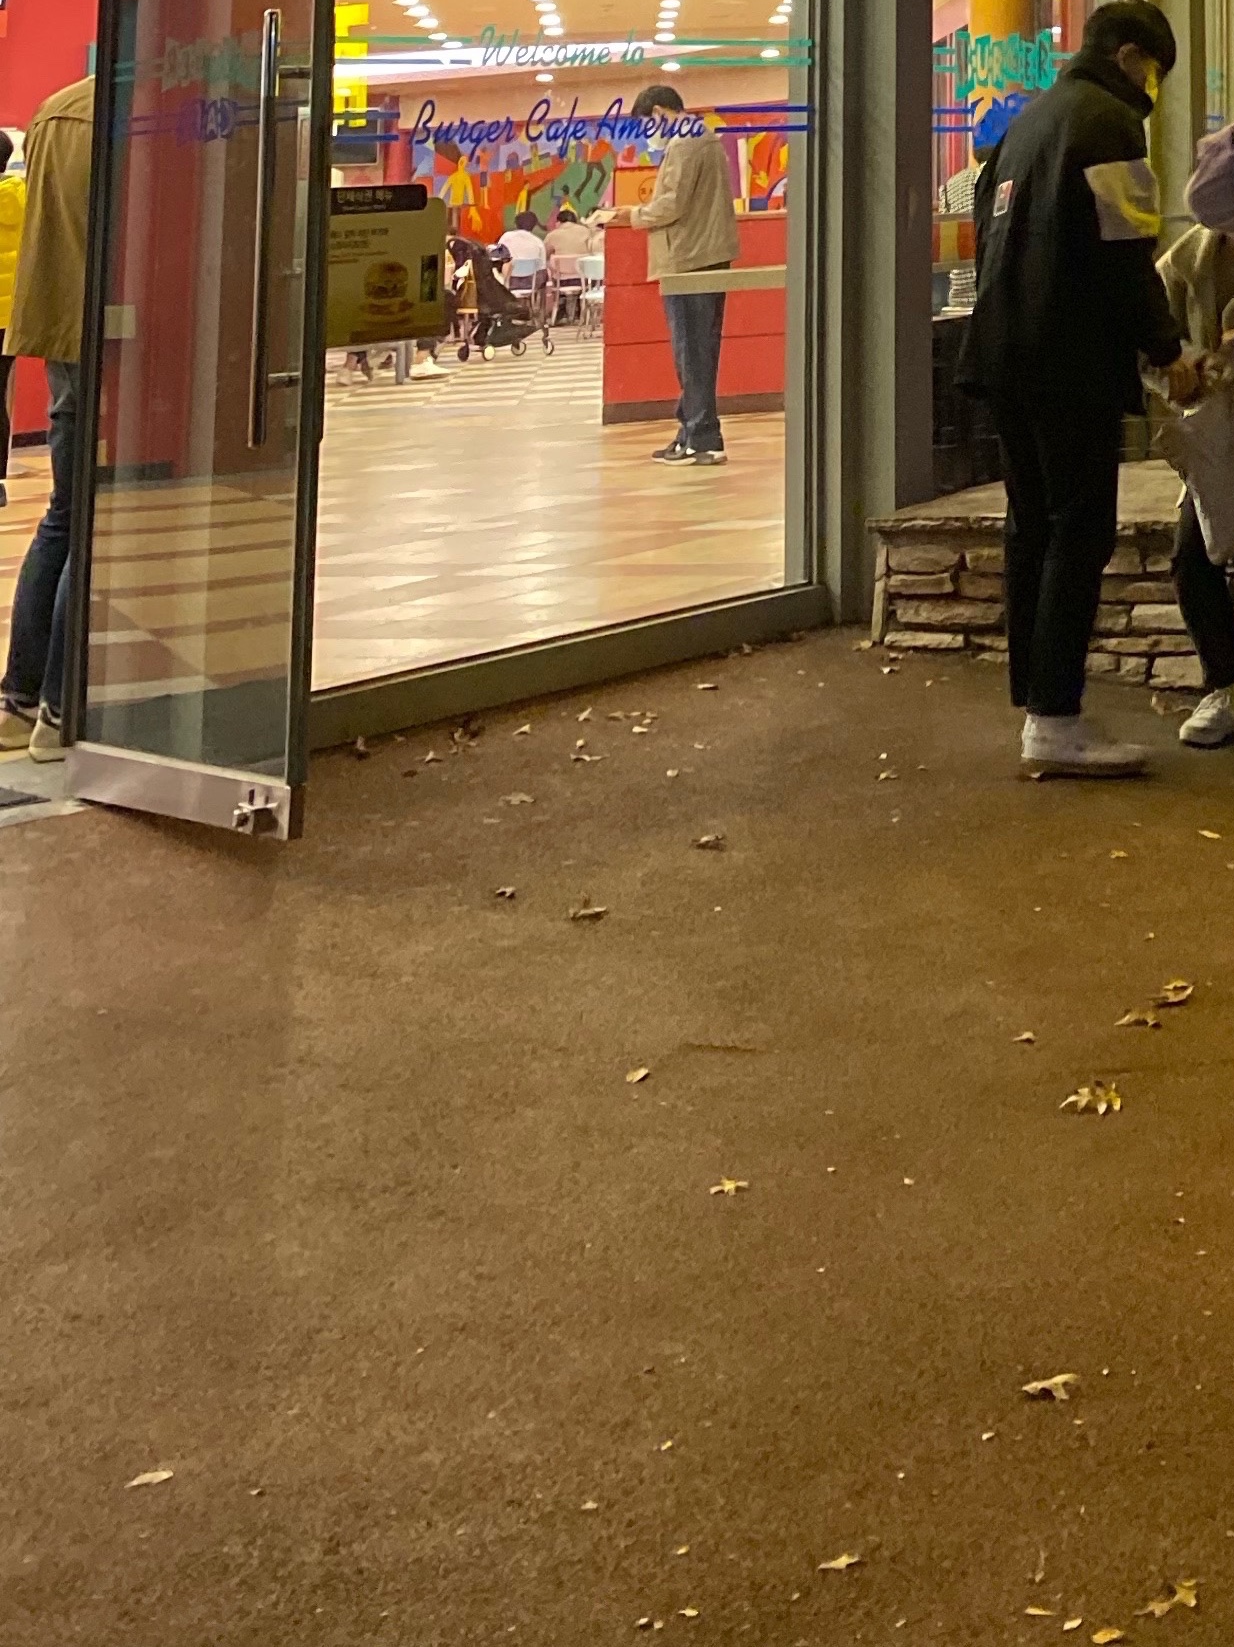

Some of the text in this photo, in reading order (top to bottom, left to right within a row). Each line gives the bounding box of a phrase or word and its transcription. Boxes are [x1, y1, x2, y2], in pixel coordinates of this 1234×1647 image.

[479, 23, 646, 67] Welcome to
[410, 96, 706, 162] Burger Cafe America
